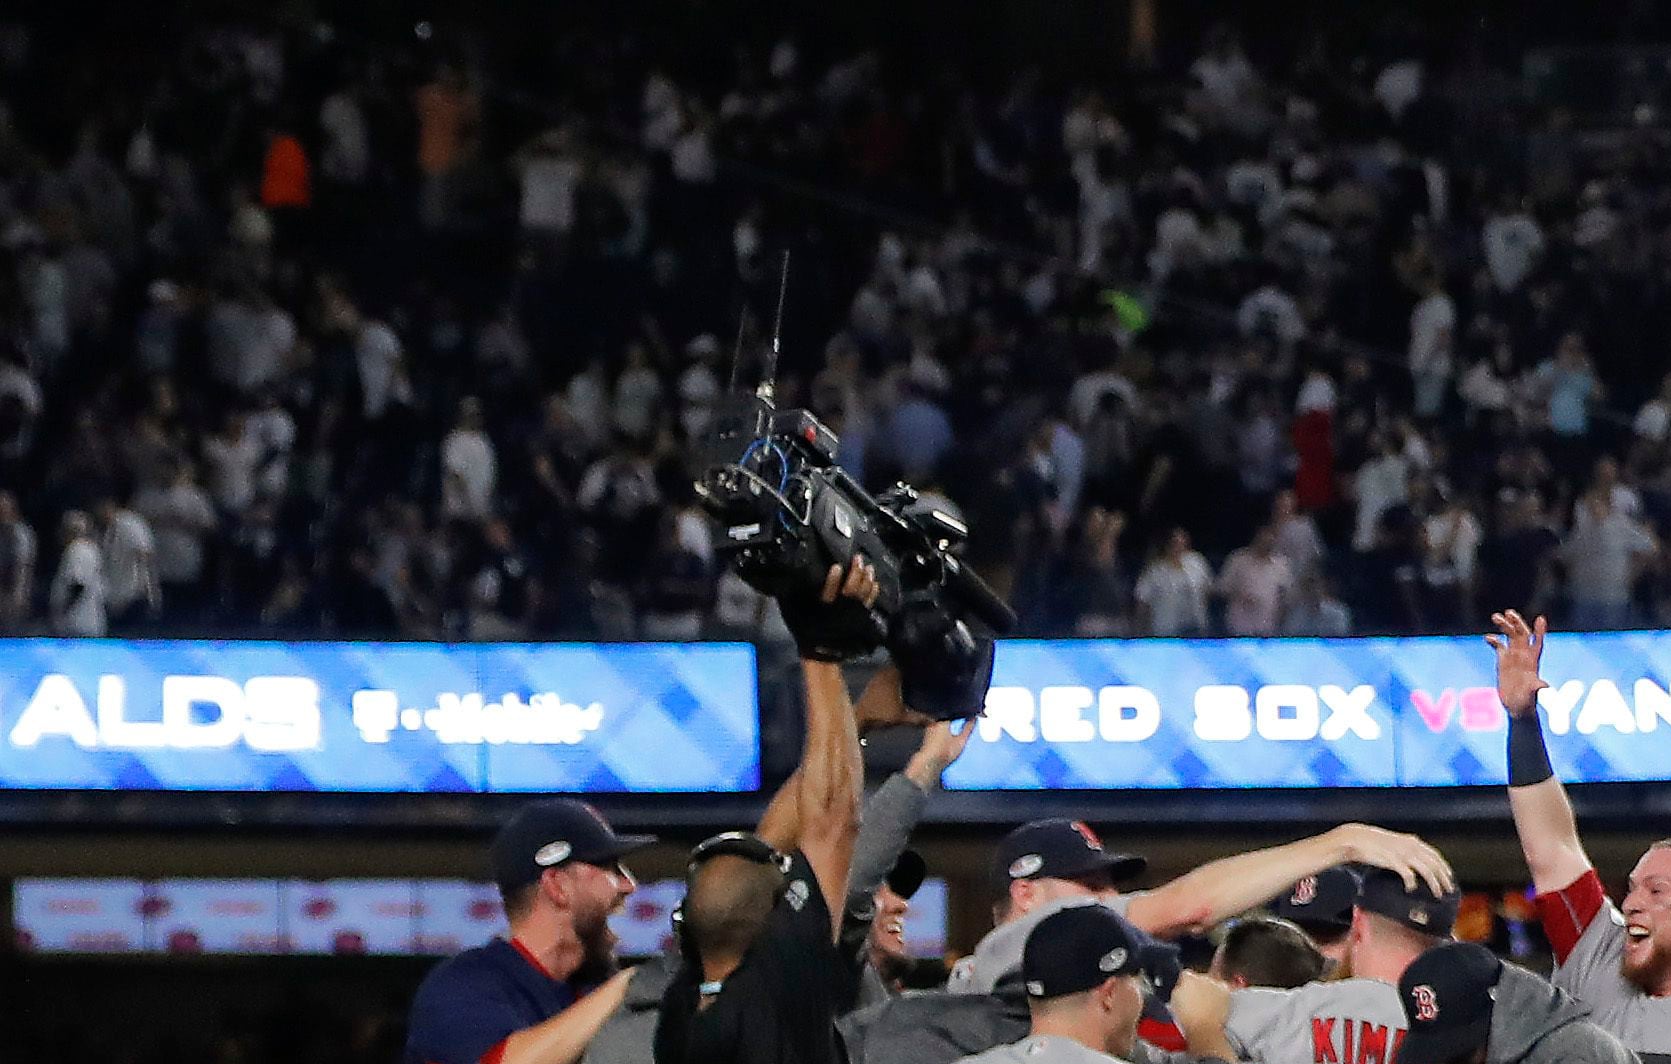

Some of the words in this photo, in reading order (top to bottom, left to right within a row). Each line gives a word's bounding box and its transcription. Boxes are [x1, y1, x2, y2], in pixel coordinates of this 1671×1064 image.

[10, 674, 322, 751] ALDS
[978, 686, 1161, 743] RED
[1193, 684, 1382, 741] SOX
[1409, 686, 1502, 733] VS
